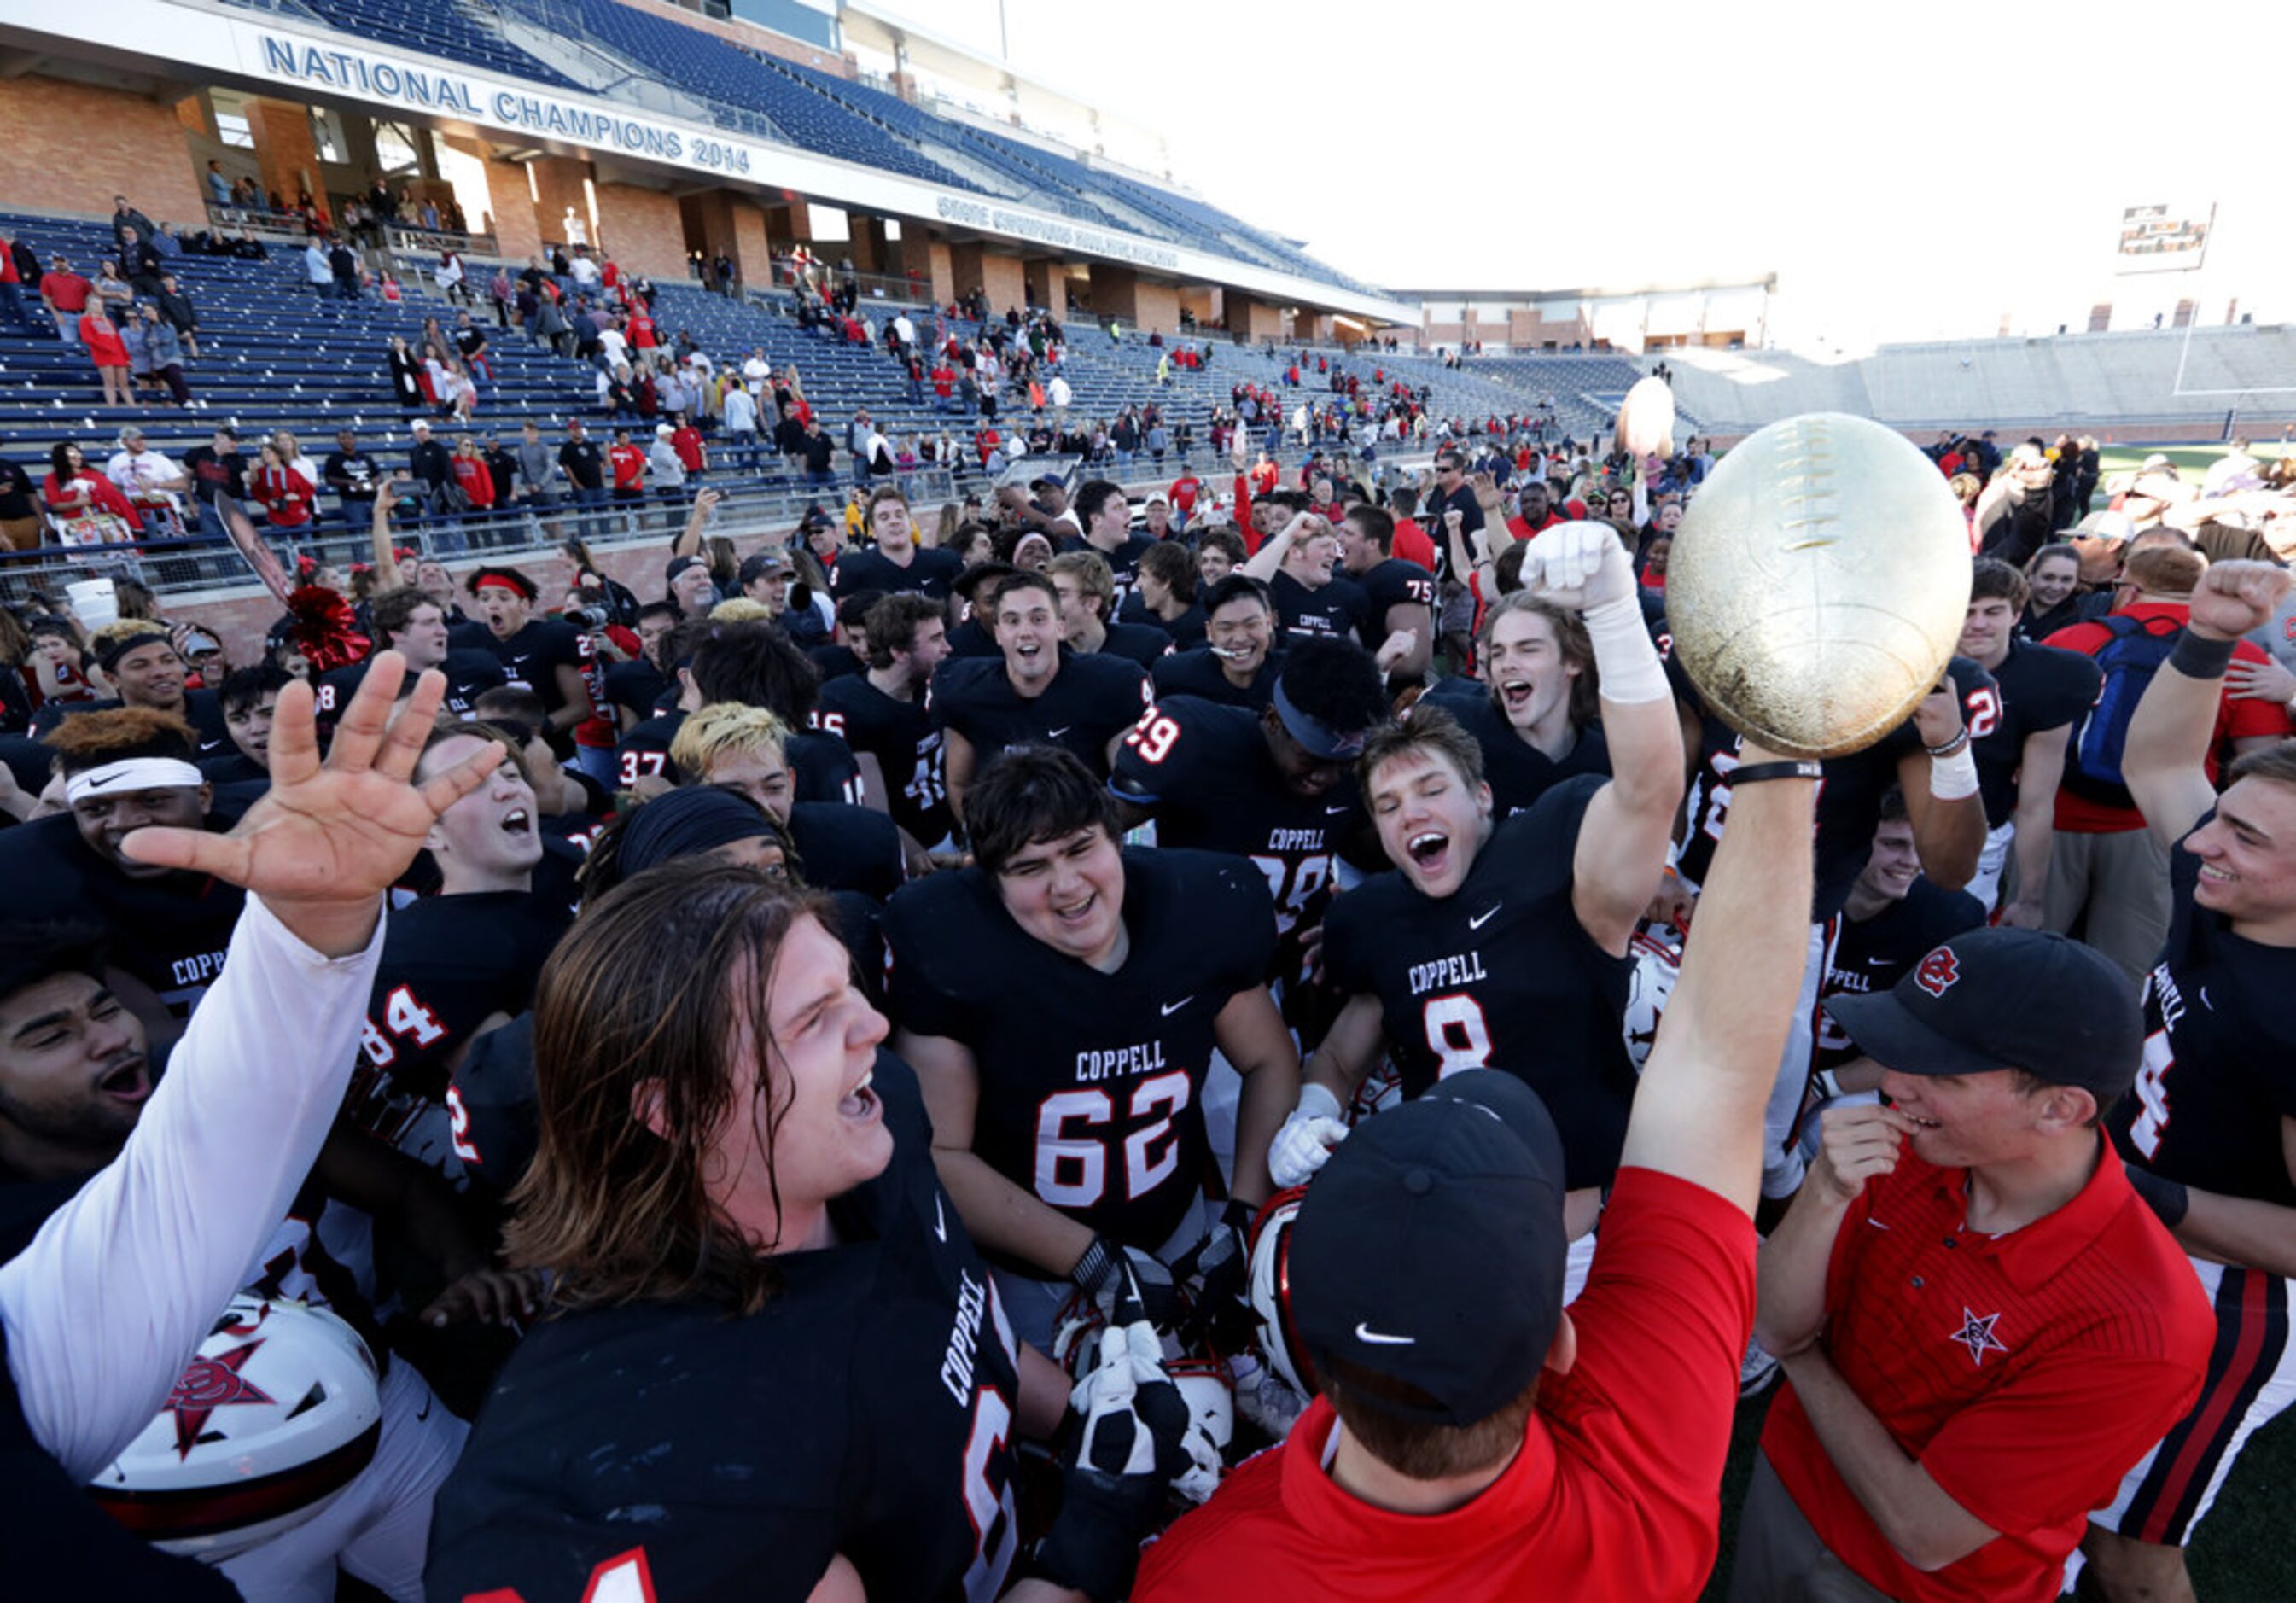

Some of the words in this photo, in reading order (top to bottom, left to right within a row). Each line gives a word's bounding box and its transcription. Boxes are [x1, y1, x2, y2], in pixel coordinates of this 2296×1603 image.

[263, 35, 484, 115] NATIONAL
[492, 90, 684, 159] CHAMPIONS
[690, 137, 750, 172] 2014
[1406, 579, 1434, 603] 75
[1965, 685, 2004, 739] 2
[619, 750, 667, 784] 37
[1268, 828, 1326, 850] COPPELL
[172, 947, 228, 986] COPP
[1409, 950, 1488, 995] COPPELL
[1075, 1039, 1167, 1082] COPPELL
[1034, 1067, 1192, 1209] 62
[941, 1267, 987, 1409] COPPELL
[961, 1384, 1020, 1603] 6
